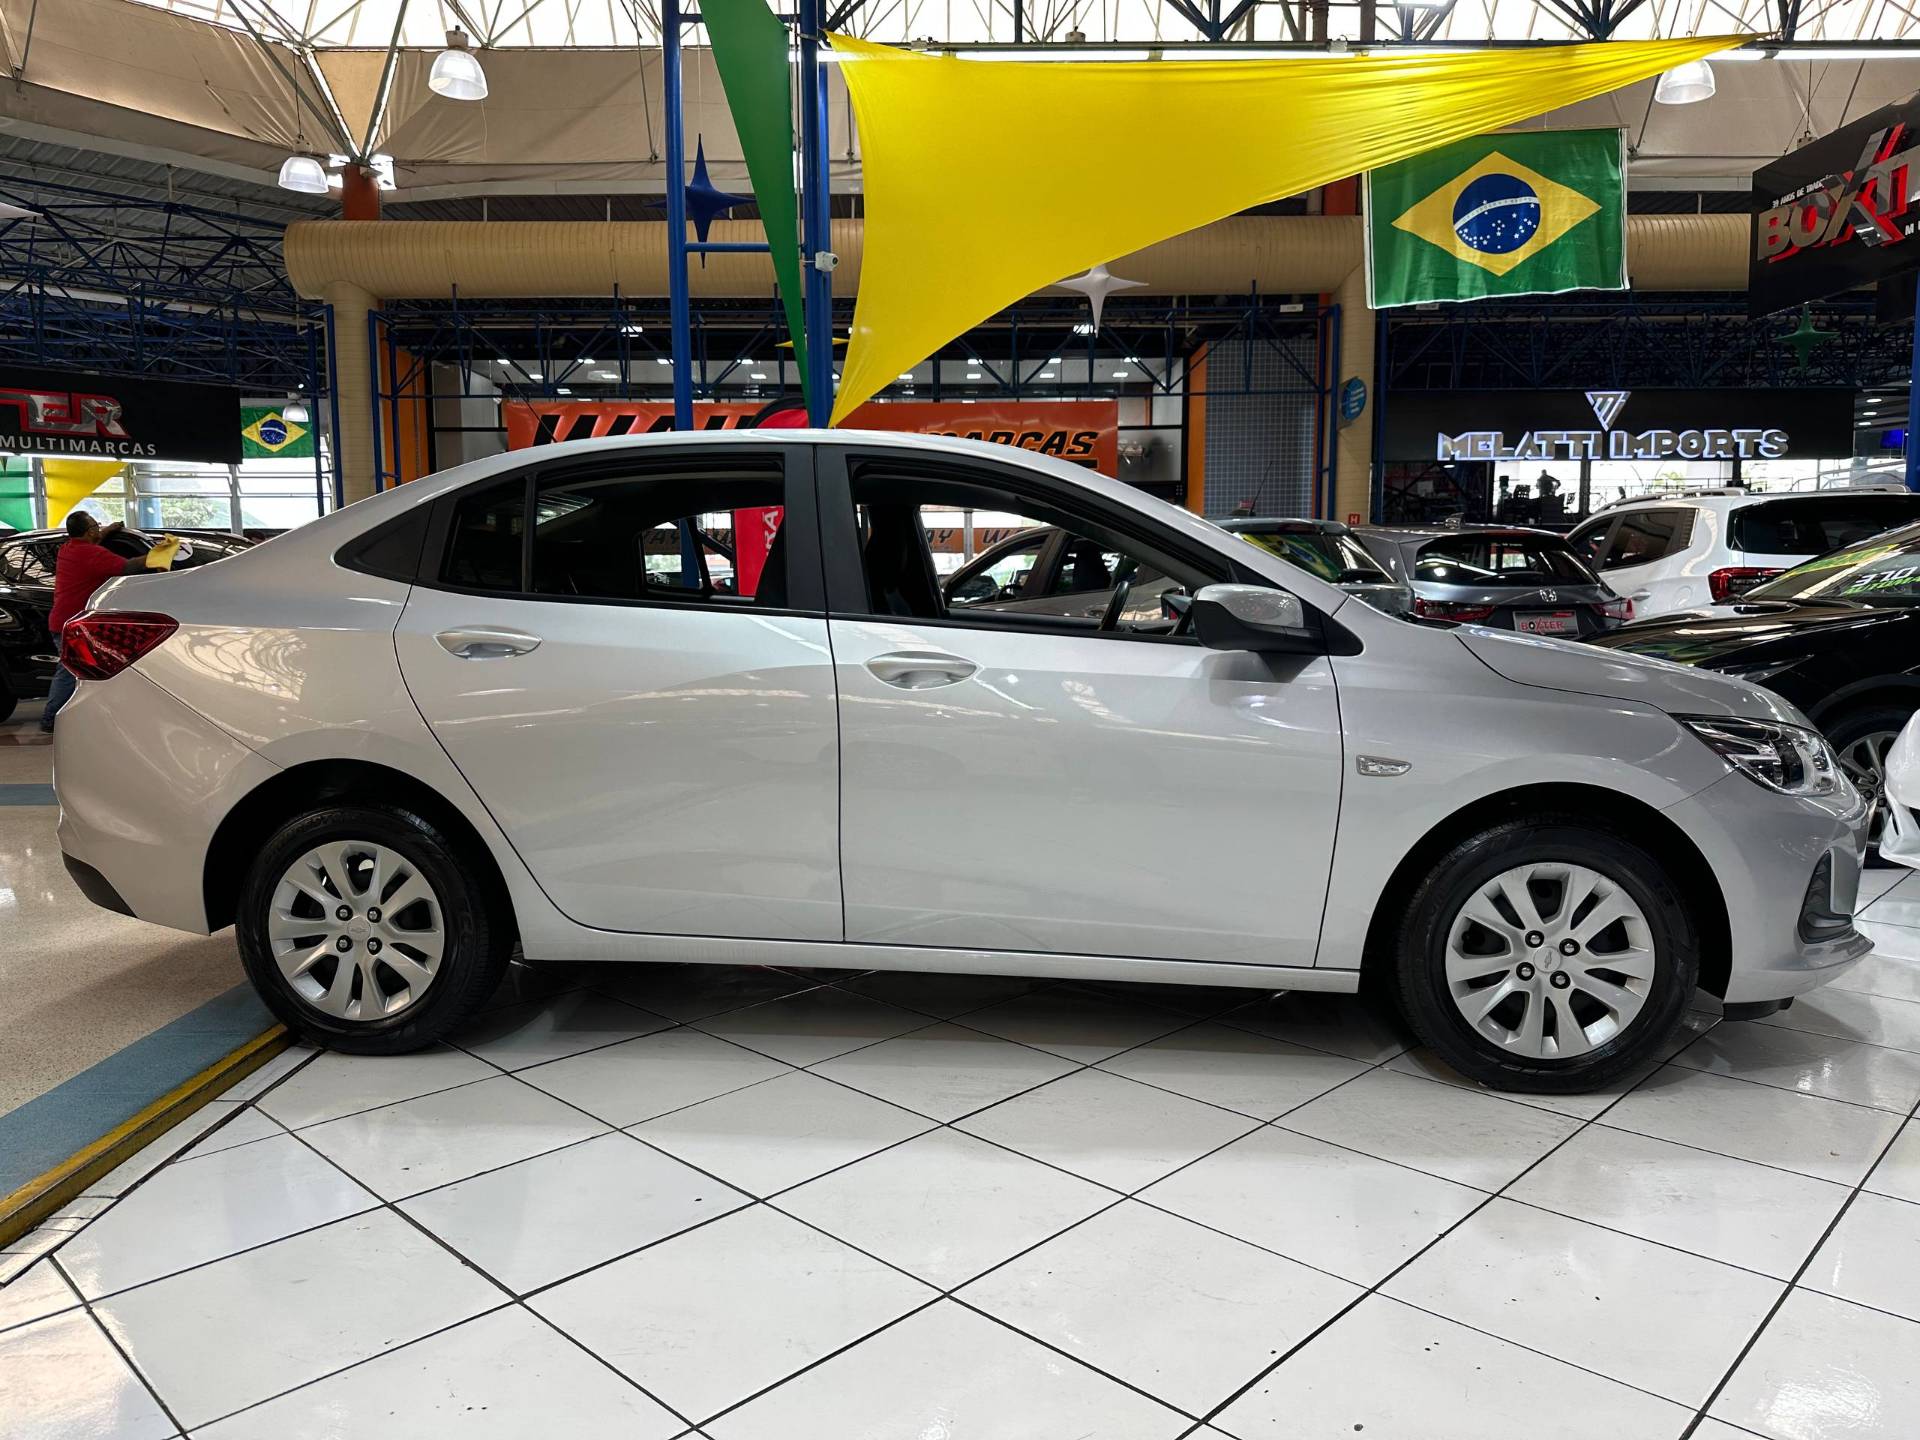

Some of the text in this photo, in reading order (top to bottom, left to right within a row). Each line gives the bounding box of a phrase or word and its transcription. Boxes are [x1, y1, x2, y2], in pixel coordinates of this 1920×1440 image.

[0, 434, 157, 456] MULTIMARCAS
[1437, 428, 1790, 461] MELATTI IMPORTS
